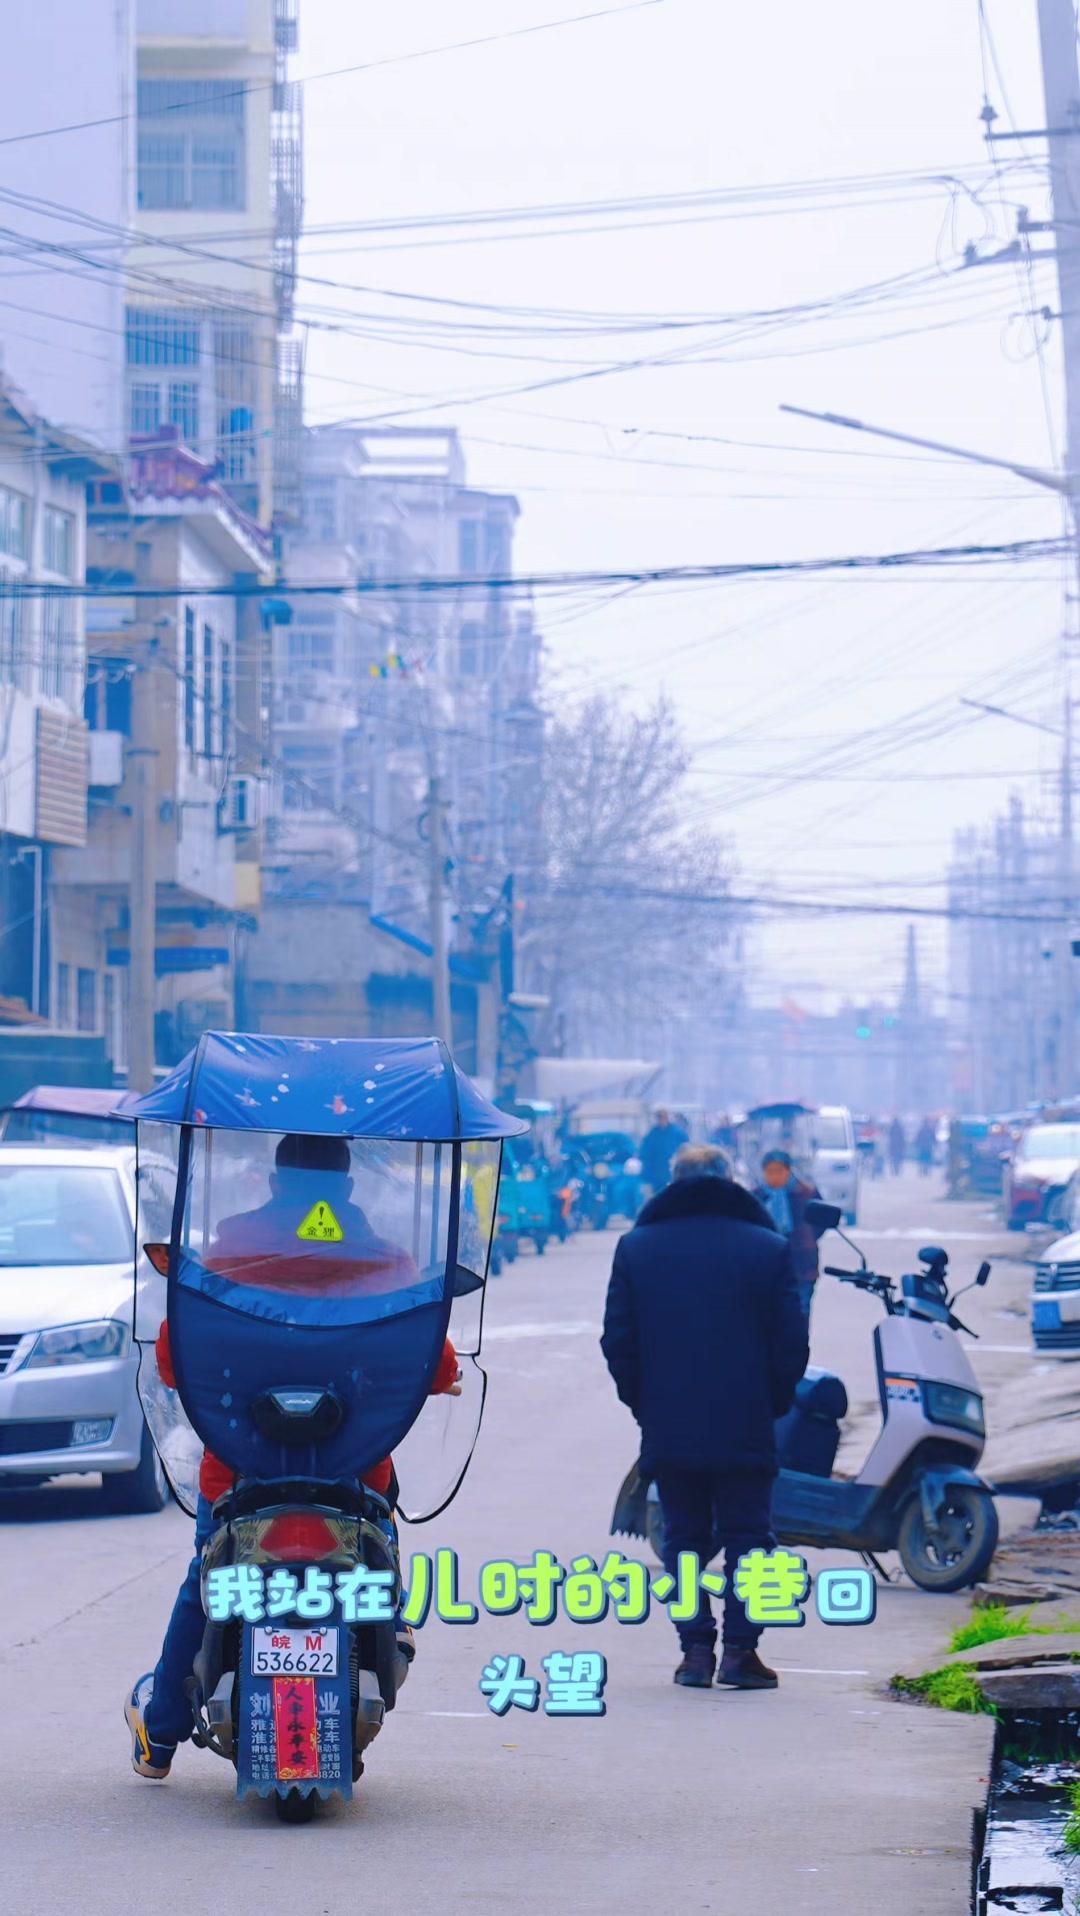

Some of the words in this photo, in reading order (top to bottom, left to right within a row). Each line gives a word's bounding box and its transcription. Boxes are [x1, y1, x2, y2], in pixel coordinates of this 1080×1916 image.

[271, 1635, 291, 1650] 皖
[305, 1635, 322, 1651] M
[256, 1651, 334, 1673] 536622
